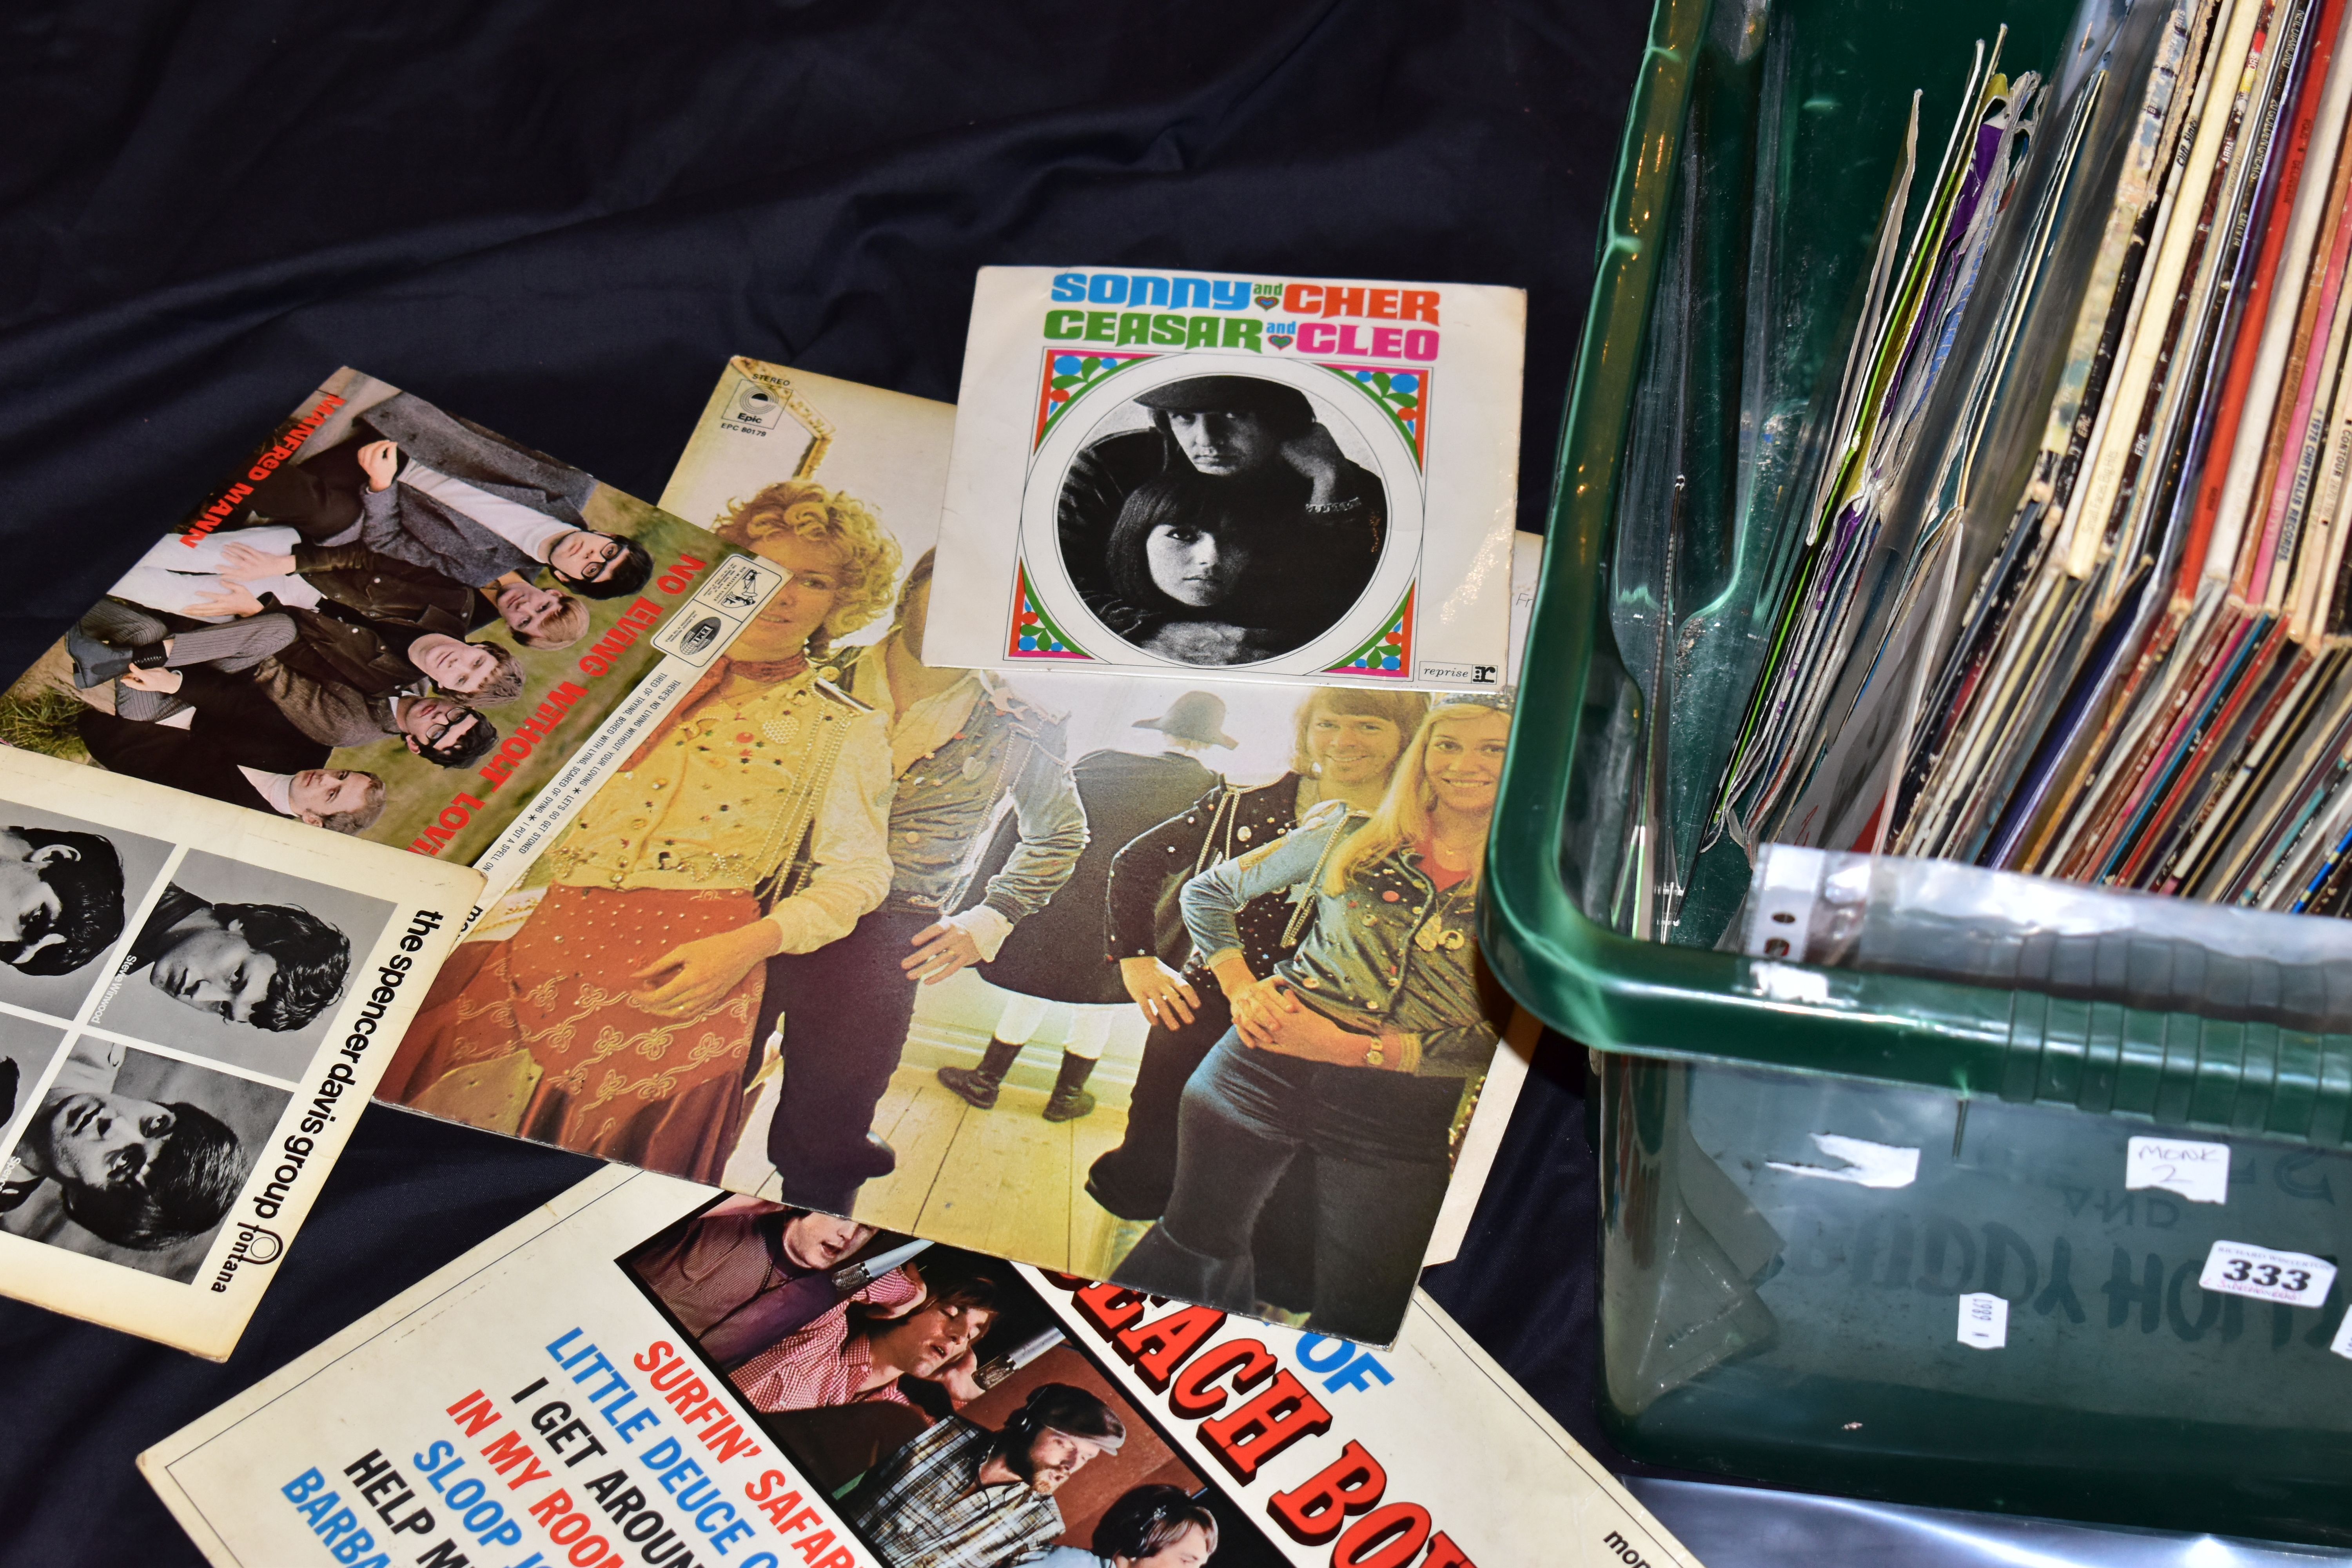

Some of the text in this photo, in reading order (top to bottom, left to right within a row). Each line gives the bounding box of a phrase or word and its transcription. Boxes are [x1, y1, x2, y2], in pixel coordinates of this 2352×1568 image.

[2282, 9, 2305, 69] NEIL DIAMOND
[2261, 110, 2276, 146] GOLDEN
[2175, 144, 2190, 167] Cliff
[2222, 140, 2234, 163] ABBA
[2250, 146, 2267, 181] GREATS
[2227, 176, 2237, 197] FIRST
[1254, 282, 1283, 298] and
[1283, 283, 1440, 326] CHER
[1043, 310, 1440, 361] CEASAR and CLEO
[752, 373, 791, 387] STEREO
[721, 423, 767, 437] EPC 80179
[737, 412, 762, 425] Epic
[2135, 433, 2148, 457] EPIC
[2334, 428, 2351, 476] CONTOUR
[2290, 444, 2316, 506] CHRYSALIS
[179, 482, 254, 549] MANN
[2082, 510, 2098, 535] Small
[2090, 482, 2107, 510] Faces
[657, 554, 708, 595] NO
[723, 572, 740, 590] MASTER'S
[713, 590, 724, 602] VOICE
[682, 618, 693, 629] GREATEST
[665, 634, 673, 642] WORLD
[670, 629, 682, 642] RECORDING
[693, 627, 709, 644] EMI
[650, 672, 668, 688] TIRED
[1424, 668, 1468, 678] reprise
[643, 688, 653, 697] OF
[622, 696, 646, 715] TRYING,
[607, 716, 627, 735] BORED
[593, 735, 610, 750] WITH
[519, 680, 682, 855] THERE'S NO LIVING WITHOUT YOUR LOVING LET'S GO GET STONED
[577, 749, 597, 765] LYING,
[559, 766, 581, 788] SCARED
[552, 787, 561, 797] OF
[535, 796, 554, 813] DYING
[512, 826, 526, 839] PUT
[490, 844, 510, 861] SPELL
[482, 862, 494, 872] ON
[90, 955, 137, 1024] Stevie Winwood
[255, 909, 444, 1220] the spencer davis group
[2138, 1144, 2220, 1162] MONK
[2151, 1164, 2194, 1183] 2
[211, 1221, 283, 1293] fontana
[2218, 1246, 2333, 1270] RICHARD WINTERTON
[2222, 1258, 2312, 1292] 333
[1295, 1331, 1395, 1394] OF
[1037, 1267, 1333, 1487] EACH
[633, 1340, 762, 1464] SURFIN'
[511, 1376, 550, 1404] I
[531, 1401, 608, 1468] GET
[446, 1388, 503, 1438] IN
[480, 1429, 552, 1491] MY
[545, 1326, 756, 1556] LITTLE DEUCE
[343, 1448, 436, 1535] HELP
[413, 1439, 522, 1547] SLOOP
